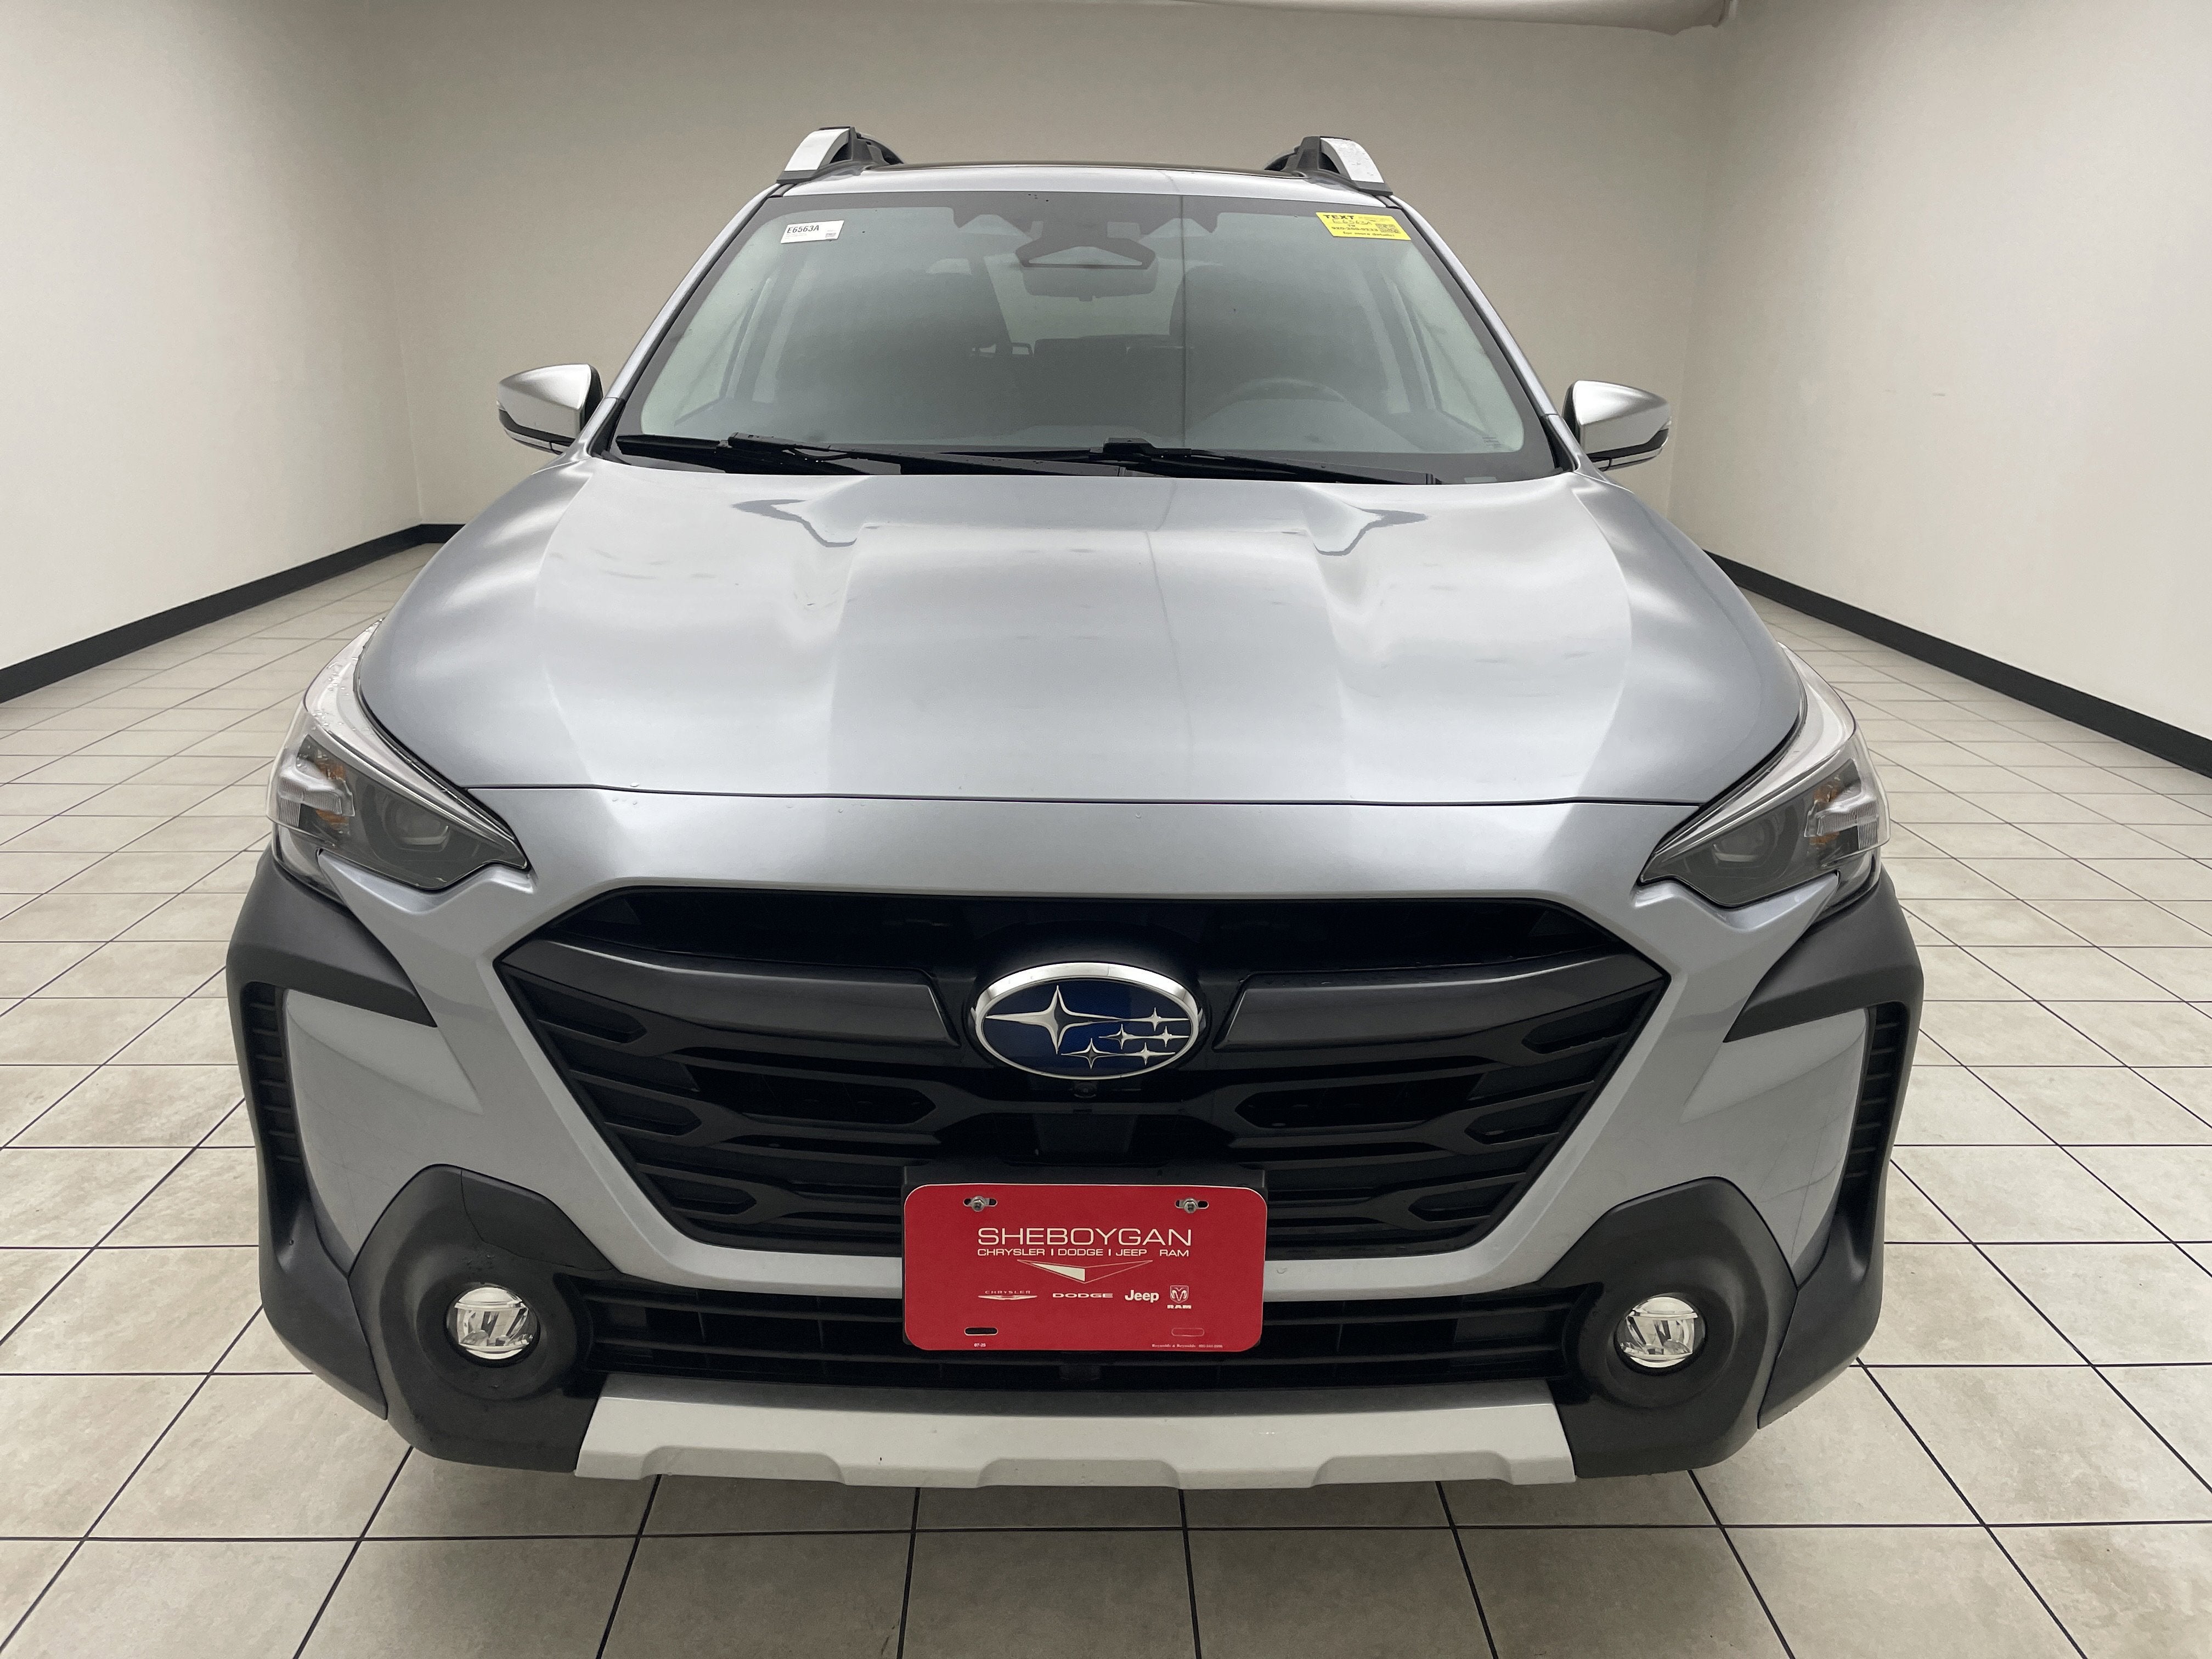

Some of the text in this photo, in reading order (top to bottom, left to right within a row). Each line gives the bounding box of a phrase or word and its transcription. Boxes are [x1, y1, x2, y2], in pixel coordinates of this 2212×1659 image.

[787, 225, 819, 233] E6563A
[978, 1228, 1192, 1246] SHEBOYGAN
[1125, 1290, 1159, 1303] Jeep
